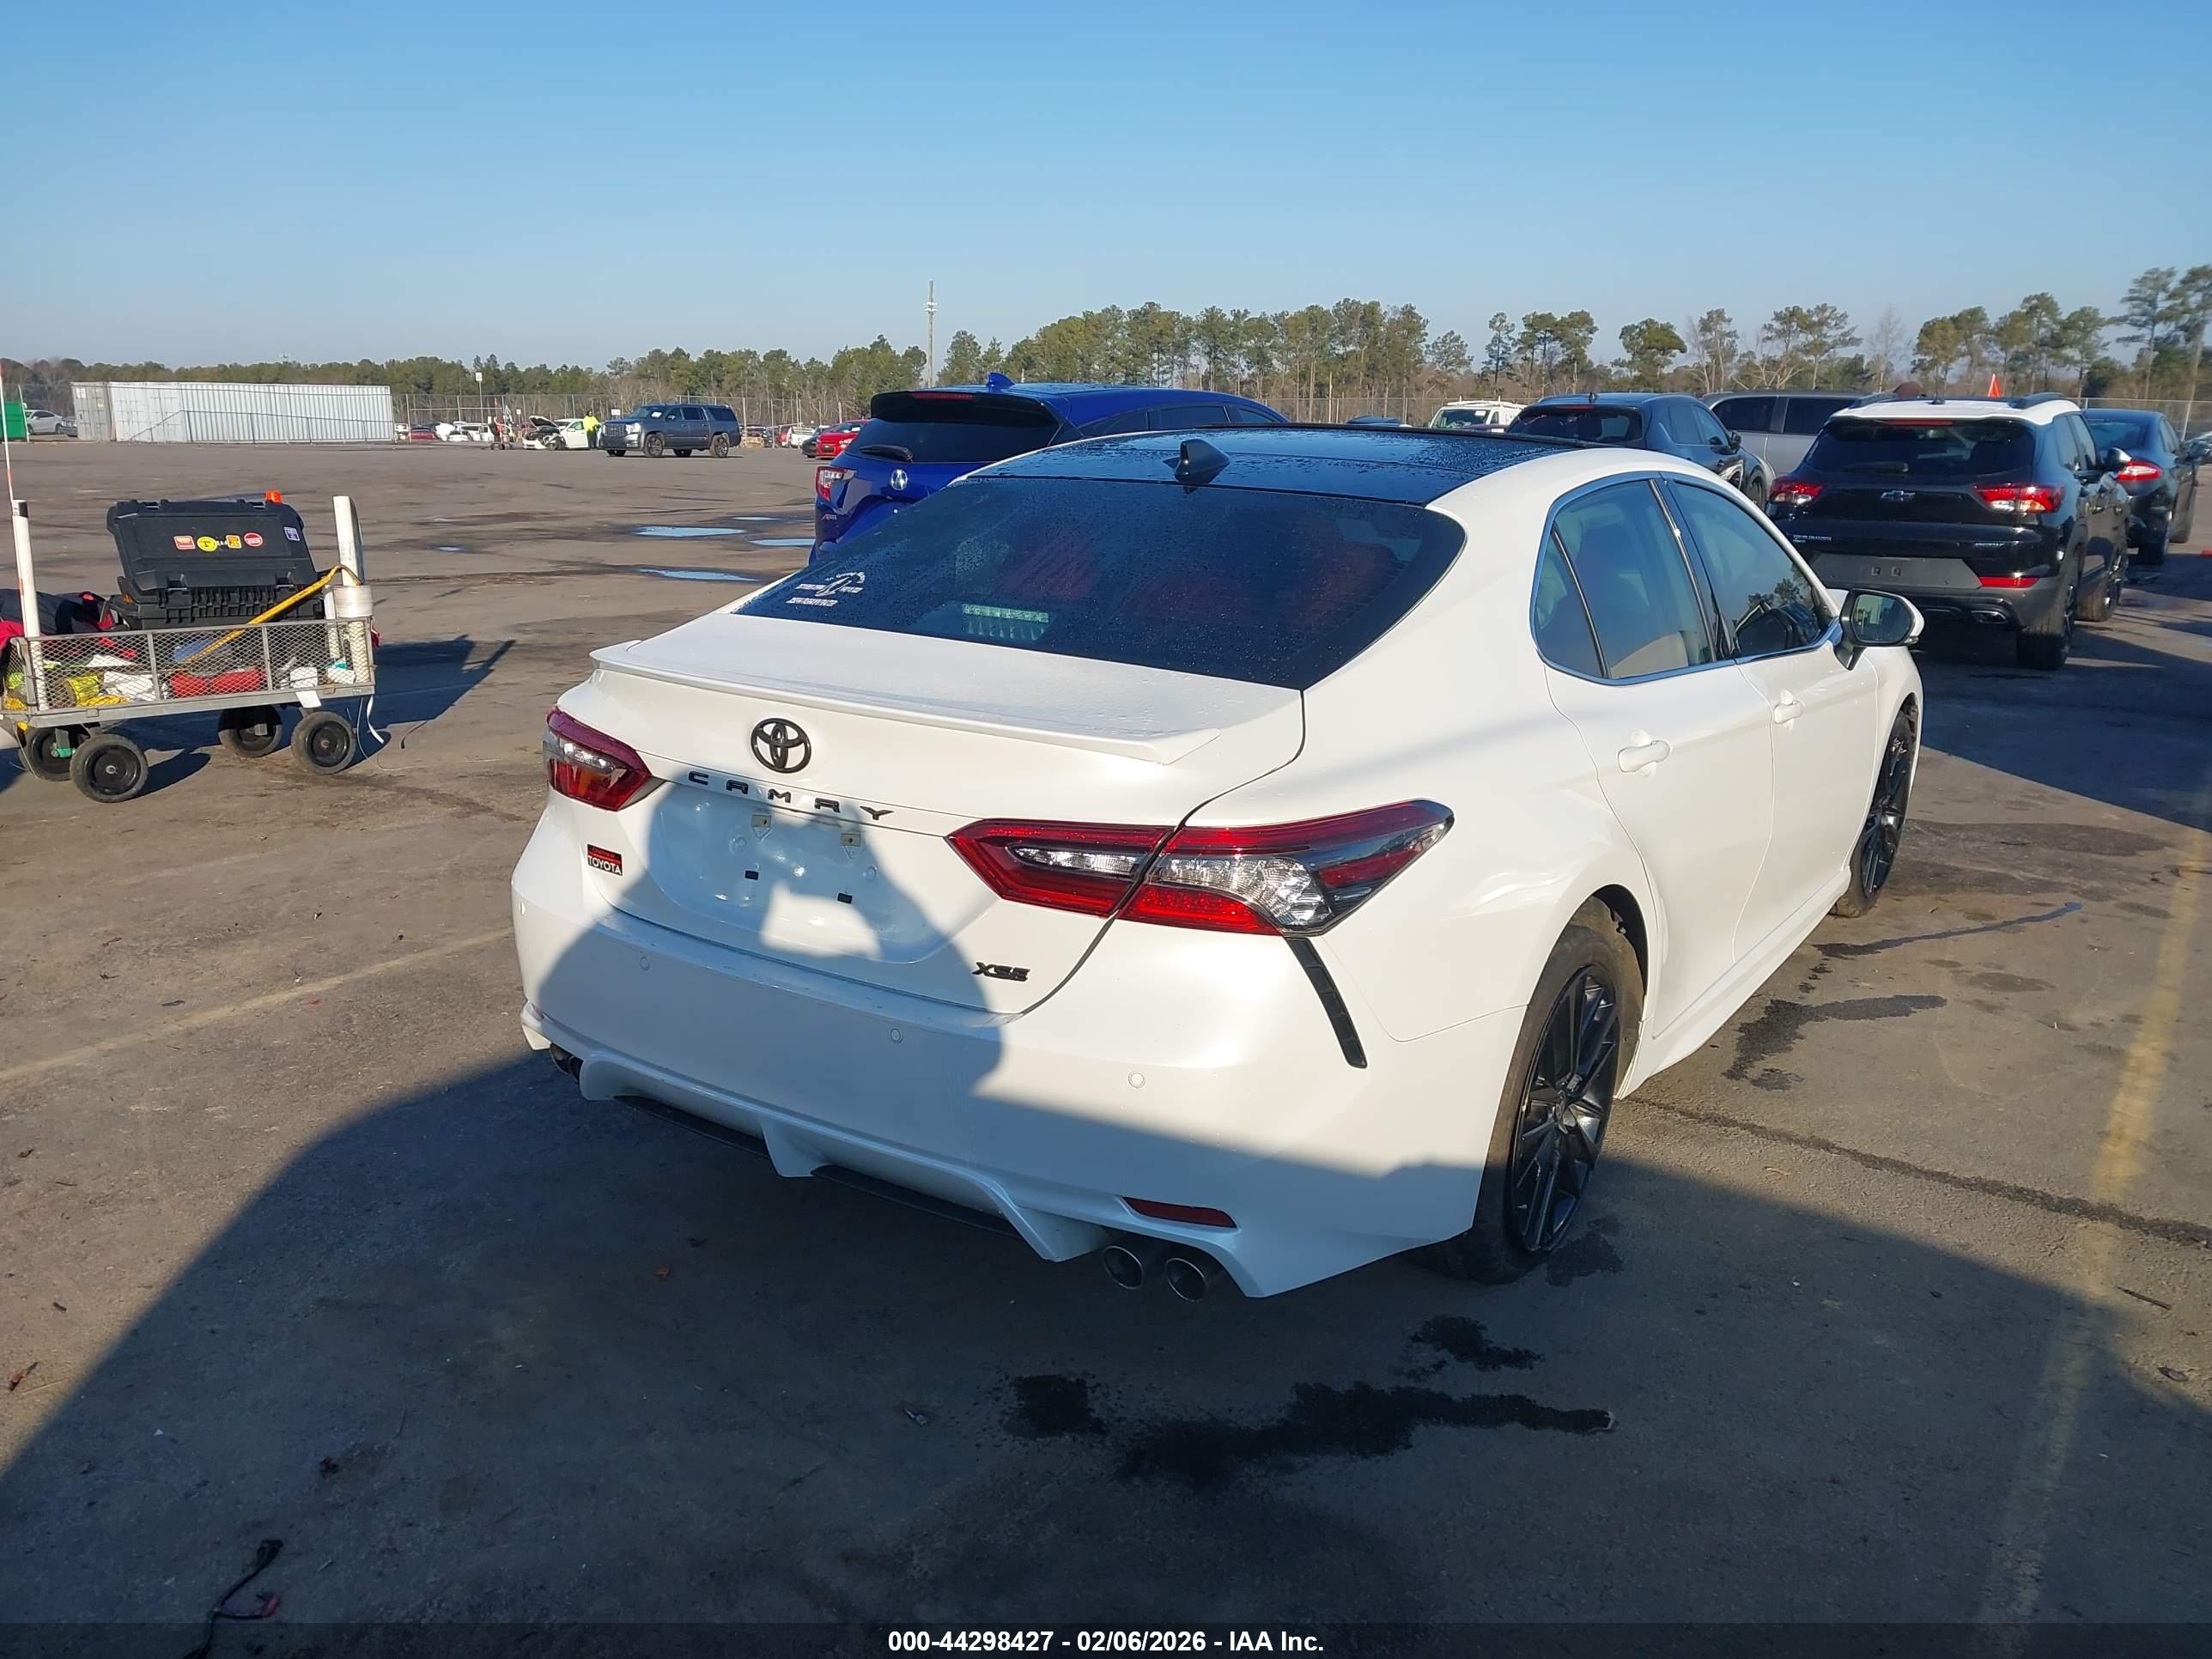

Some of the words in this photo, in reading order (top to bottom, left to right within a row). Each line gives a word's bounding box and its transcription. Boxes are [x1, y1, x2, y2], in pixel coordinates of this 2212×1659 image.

[688, 770, 895, 821] CAMRY
[587, 855, 622, 875] TOYOTA
[971, 962, 1030, 981] XSE
